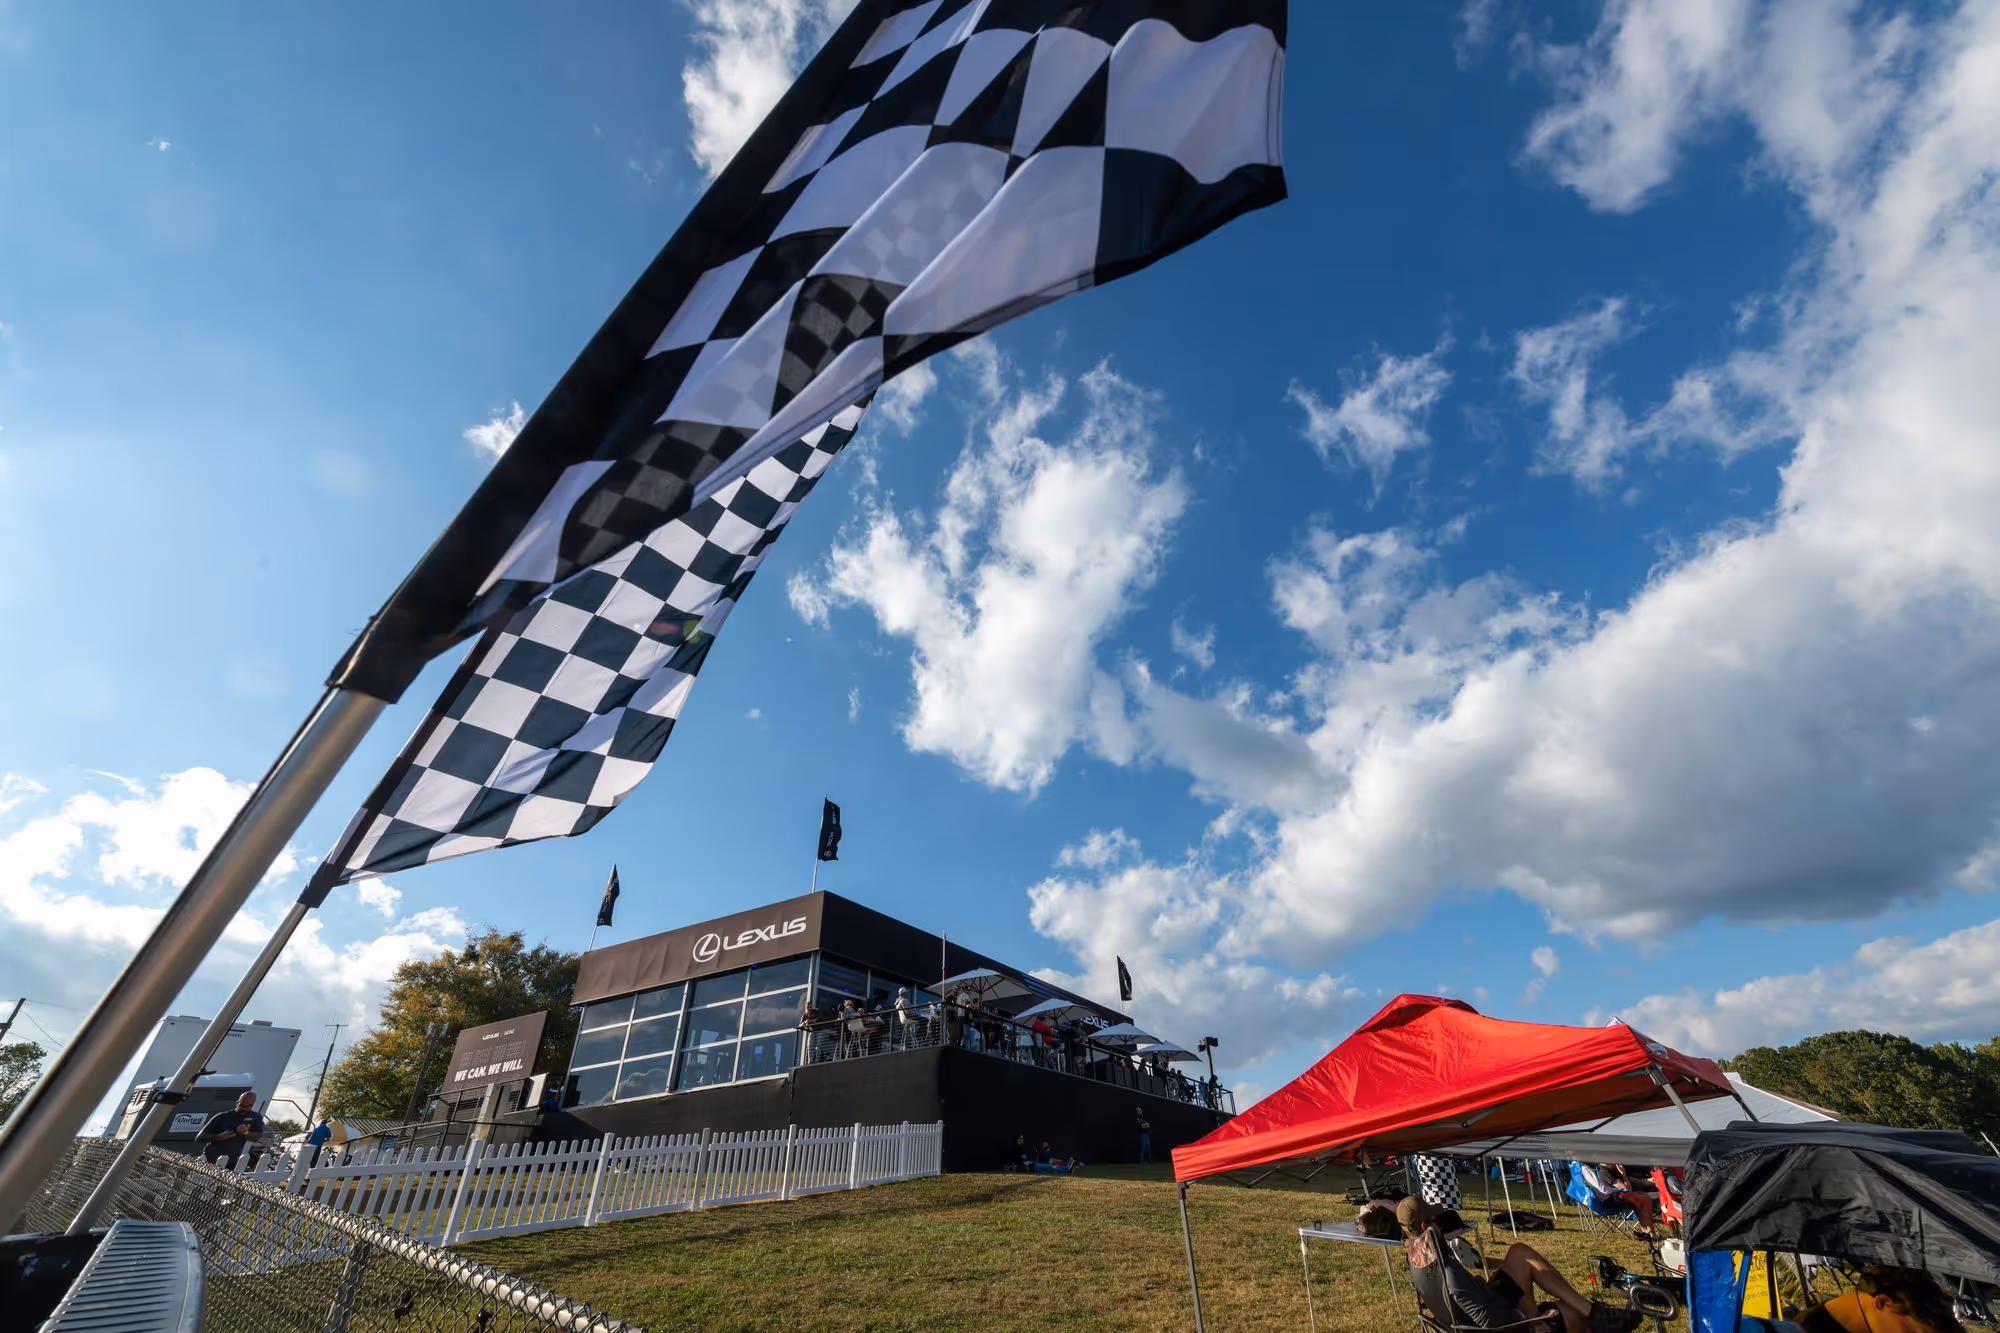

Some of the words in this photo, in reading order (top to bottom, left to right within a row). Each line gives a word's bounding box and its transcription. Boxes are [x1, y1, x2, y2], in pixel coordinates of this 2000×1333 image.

[723, 916, 807, 951] LEXUS
[454, 1069, 468, 1082] WE
[467, 1065, 487, 1079] CAN.
[488, 1063, 502, 1076] WE
[176, 1116, 203, 1124] United
